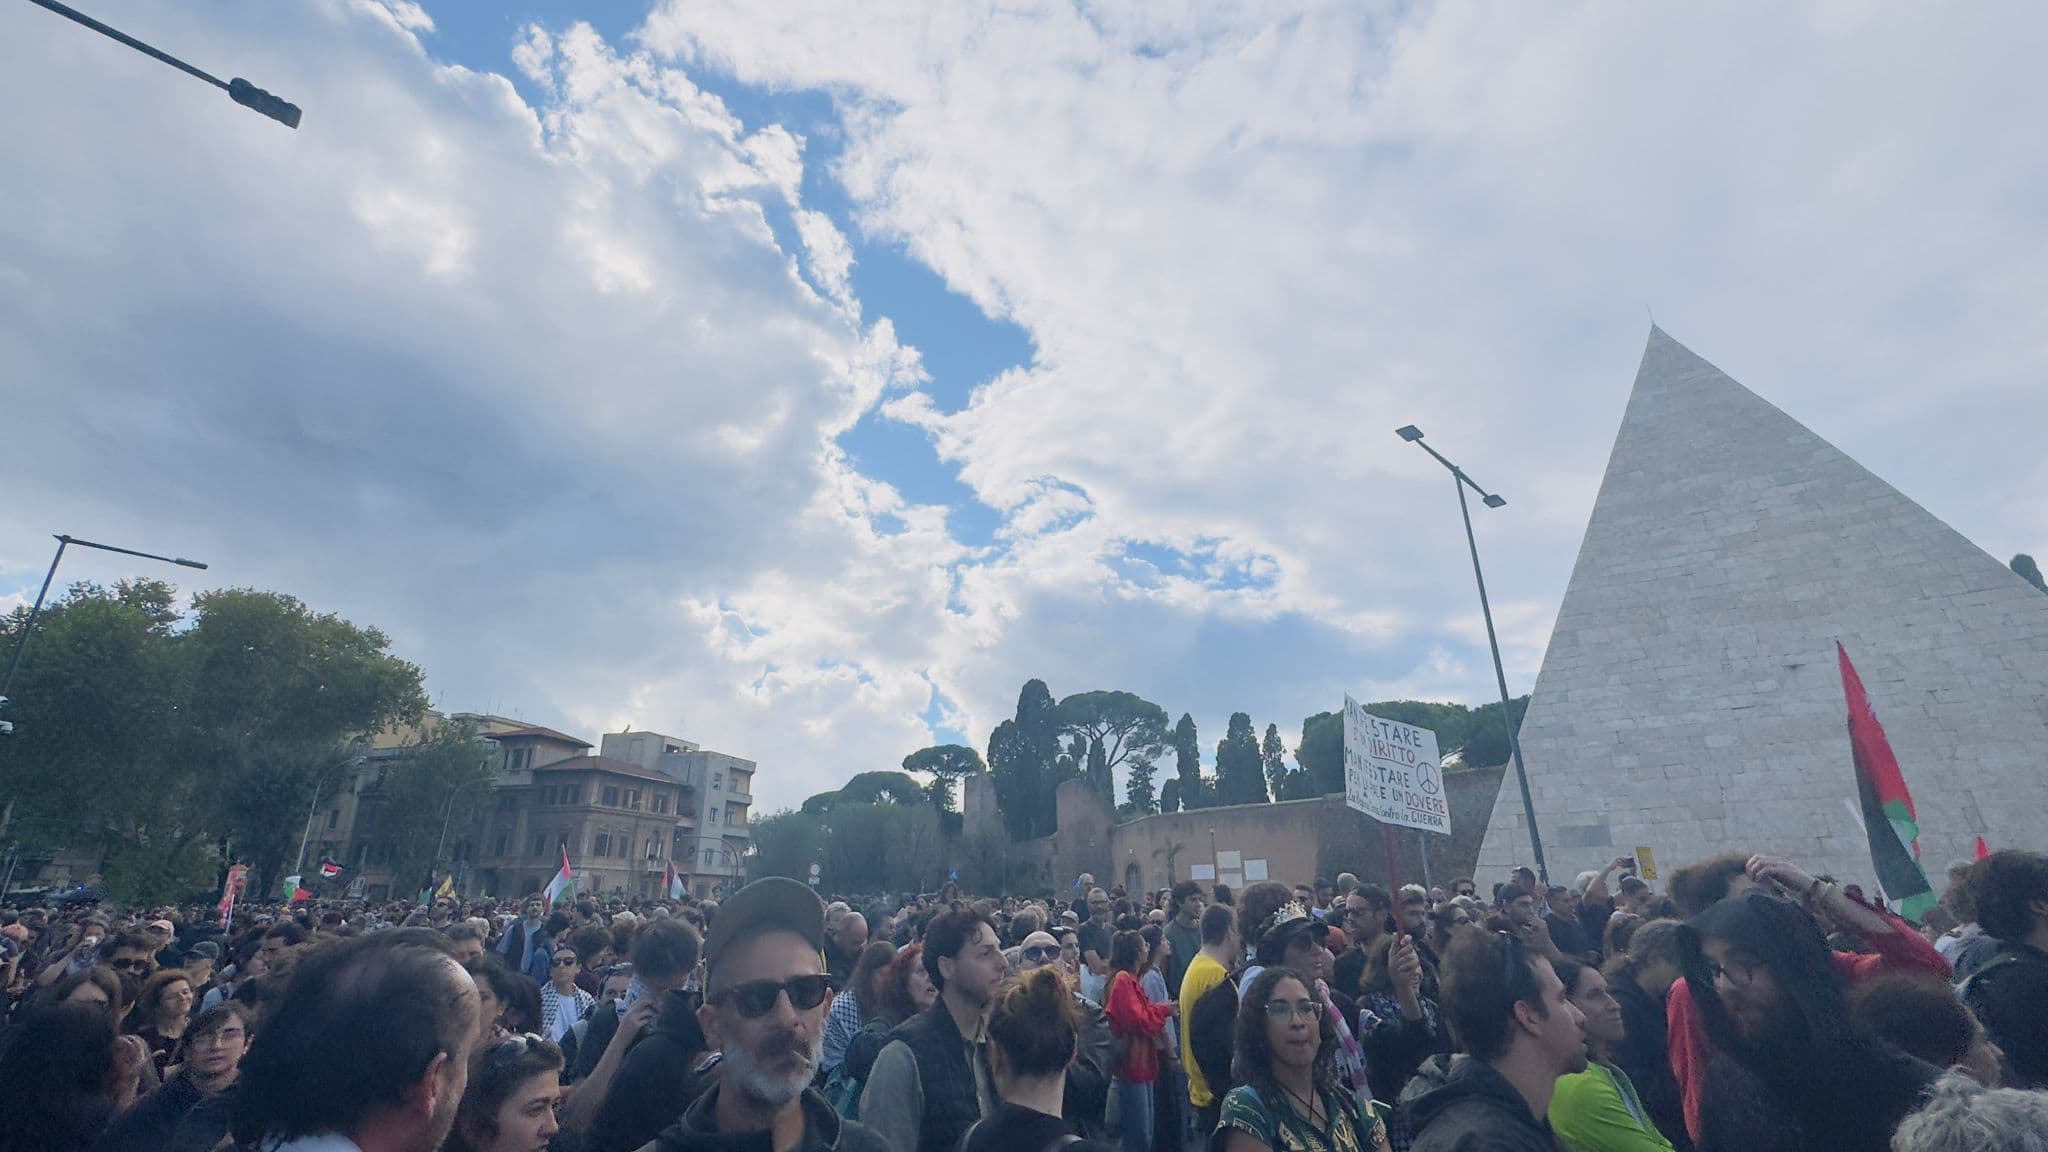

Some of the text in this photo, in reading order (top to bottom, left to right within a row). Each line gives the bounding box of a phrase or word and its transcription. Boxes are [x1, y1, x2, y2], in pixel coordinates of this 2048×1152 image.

[1392, 788, 1404, 803] UN
[1405, 790, 1446, 814] DOVERE
[1411, 810, 1444, 827] GUERRA
